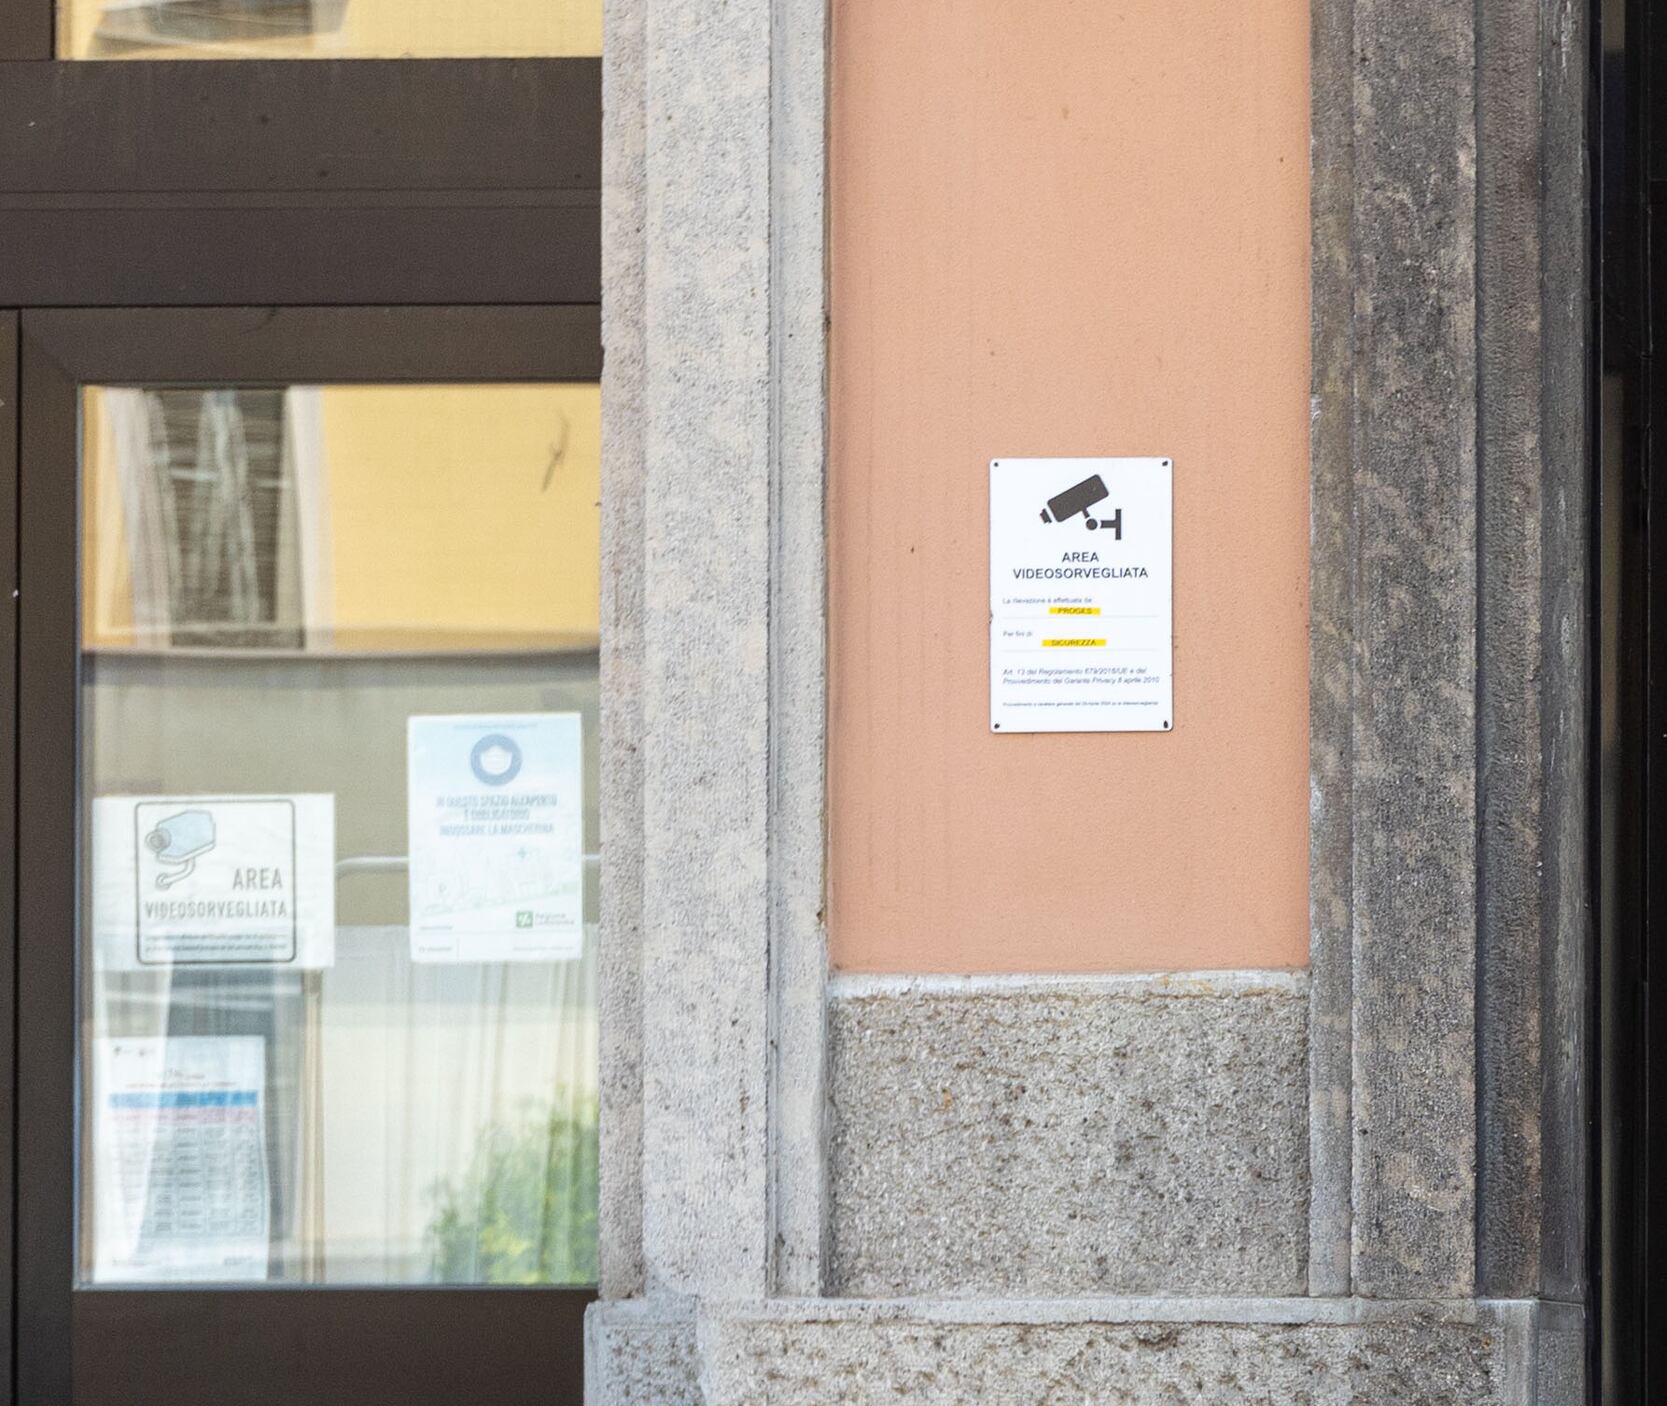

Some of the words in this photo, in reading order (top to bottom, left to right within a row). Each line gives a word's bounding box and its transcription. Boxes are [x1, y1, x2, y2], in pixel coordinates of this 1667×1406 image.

[1061, 551, 1100, 563] AREA
[1012, 567, 1149, 580] VIDEOSORVEGLIATA
[231, 867, 284, 891] AREA
[144, 900, 288, 920] VIDEOSORVEGLIATA
